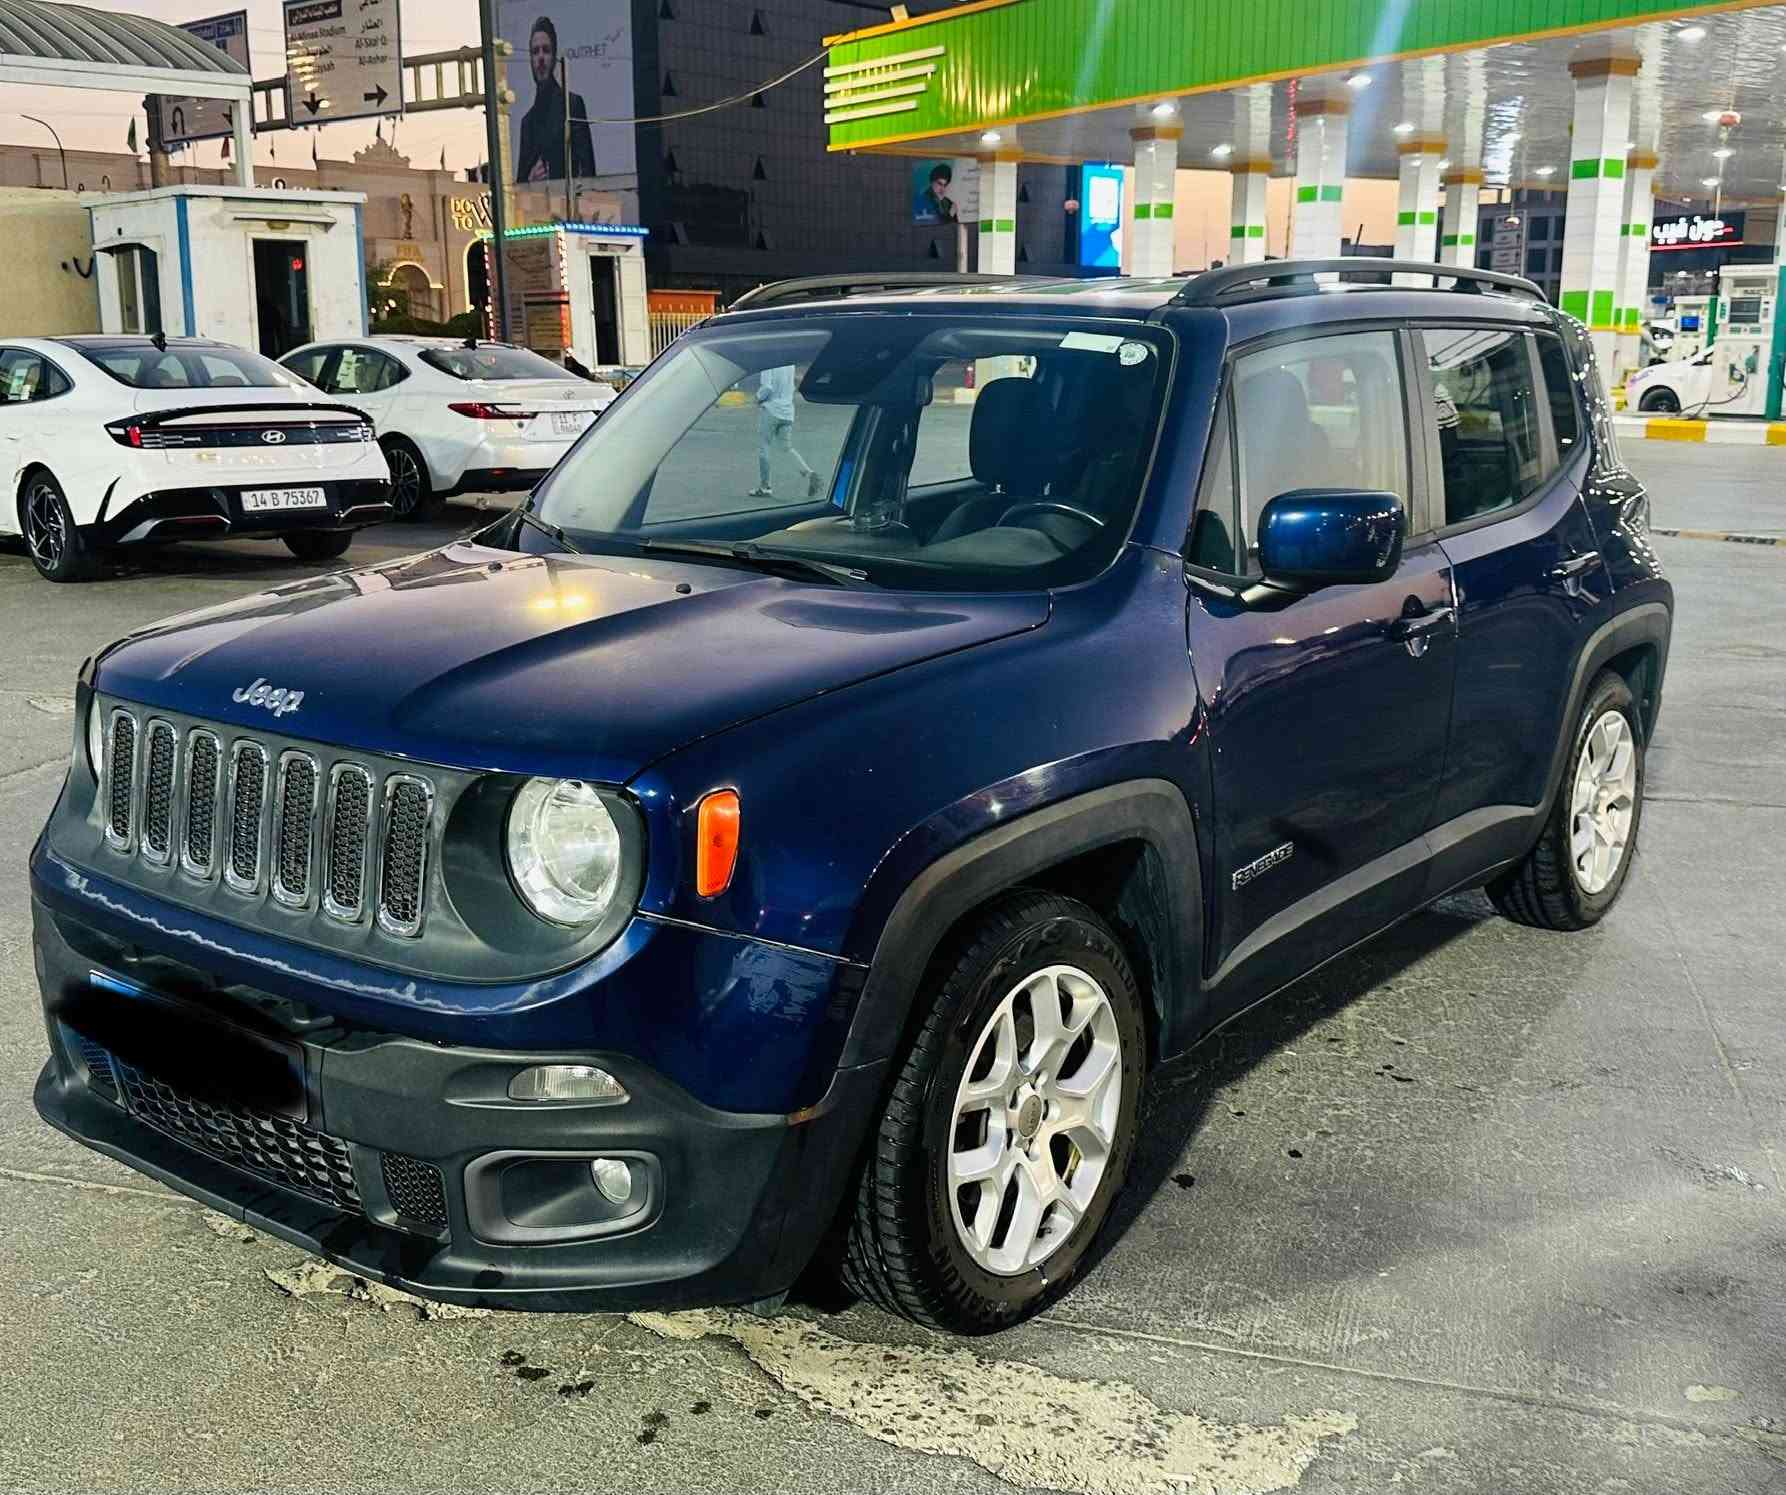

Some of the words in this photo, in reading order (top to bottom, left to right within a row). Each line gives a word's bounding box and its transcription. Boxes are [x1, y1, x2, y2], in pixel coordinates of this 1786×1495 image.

[251, 493, 267, 508] 14
[271, 491, 280, 507] B
[283, 489, 320, 506] 75367
[232, 677, 304, 717] Jeep
[1231, 841, 1293, 890] RENEGADE
